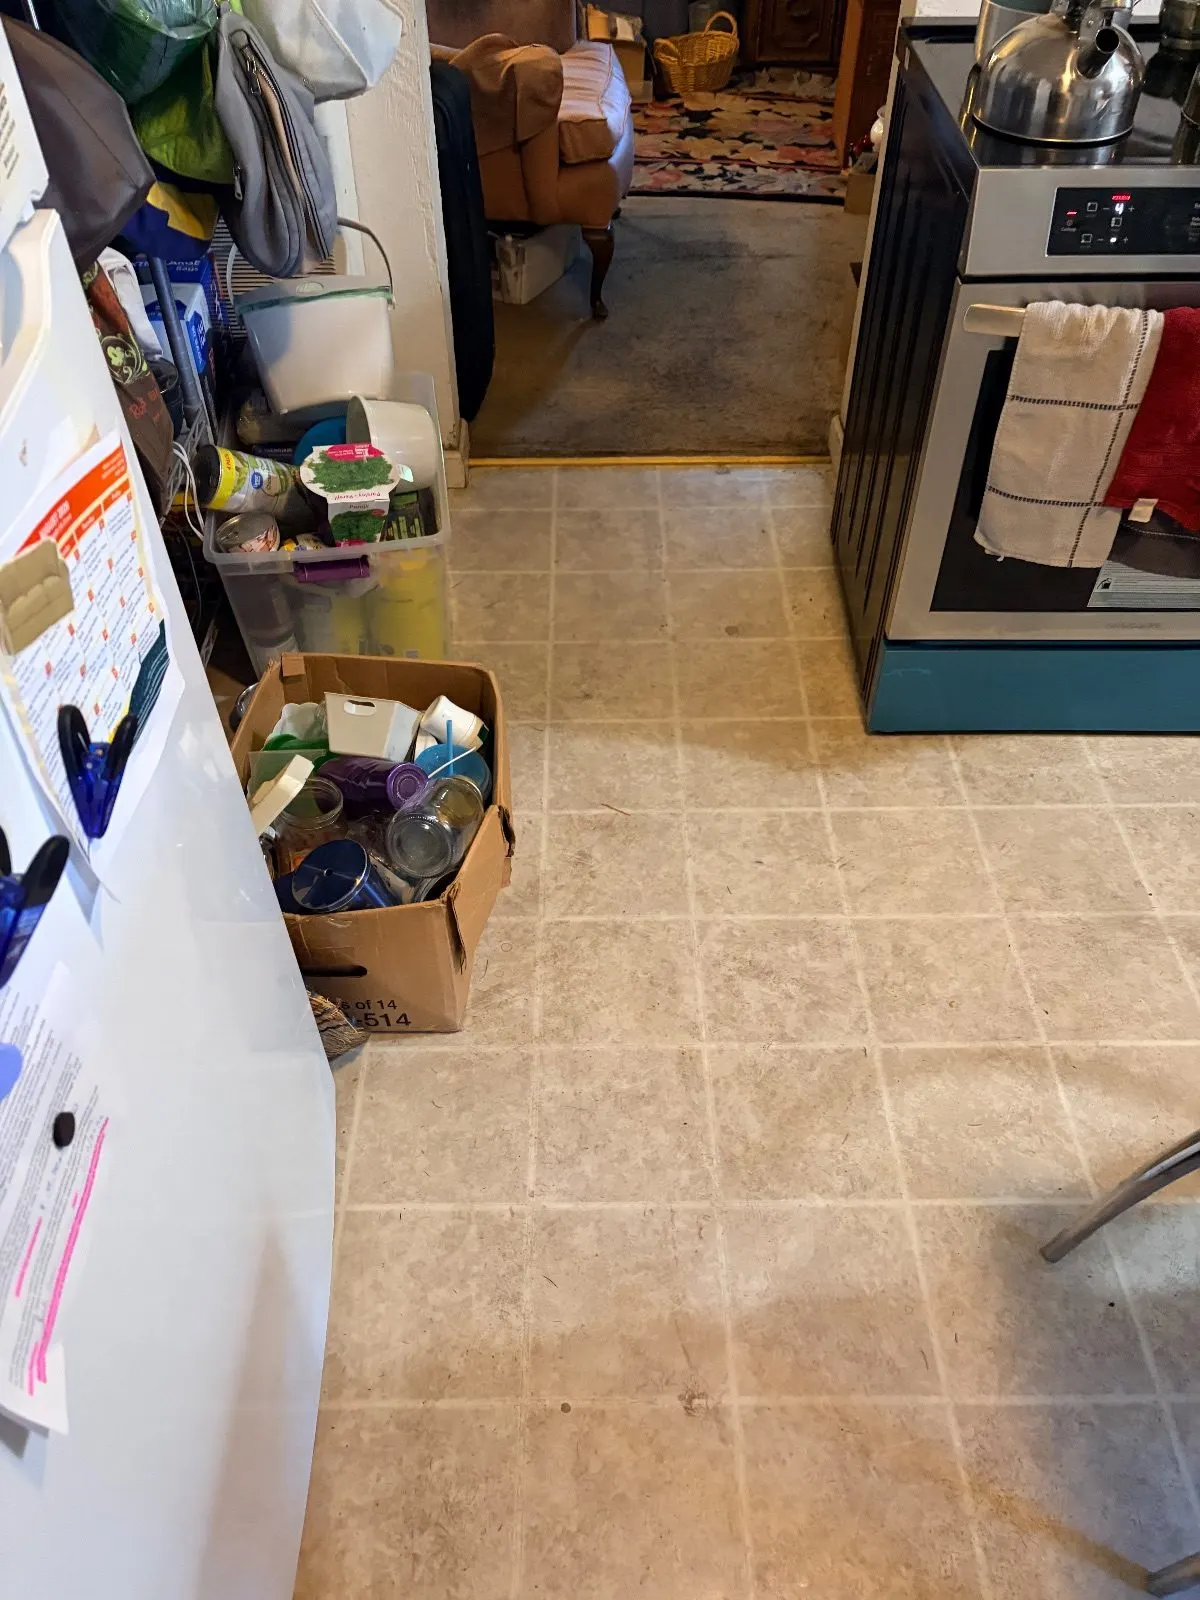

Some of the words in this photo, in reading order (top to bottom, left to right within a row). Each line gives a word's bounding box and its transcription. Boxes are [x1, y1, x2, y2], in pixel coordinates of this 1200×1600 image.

[1115, 203, 1124, 214] 4
[355, 1000, 372, 1010] of
[377, 1000, 397, 1009] 14
[357, 1013, 411, 1027] -514
